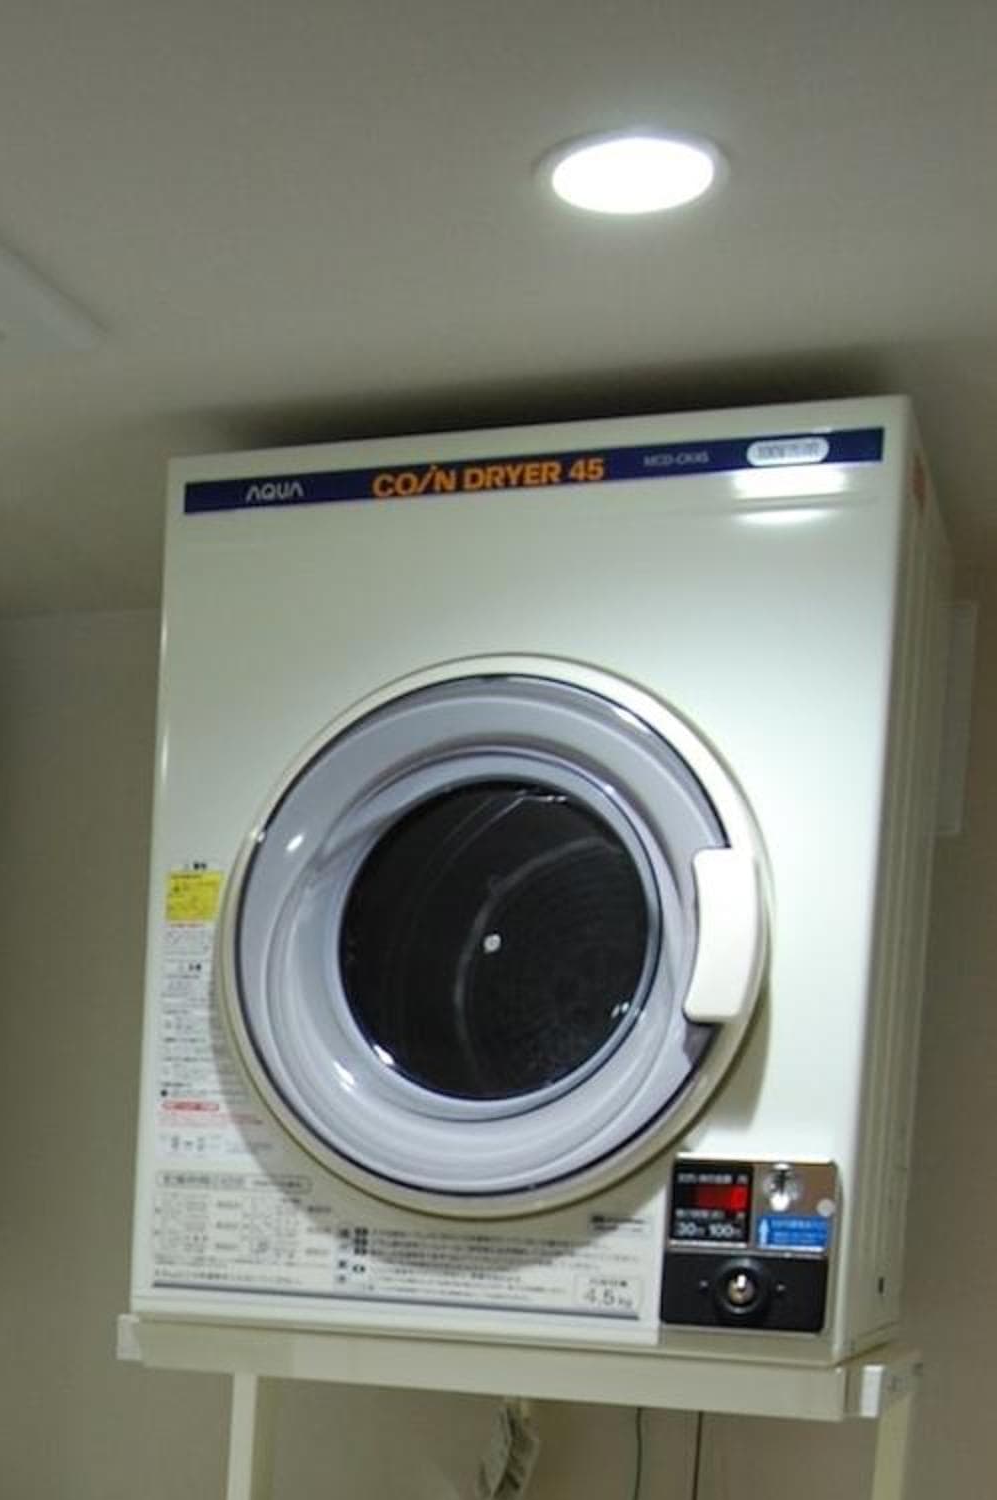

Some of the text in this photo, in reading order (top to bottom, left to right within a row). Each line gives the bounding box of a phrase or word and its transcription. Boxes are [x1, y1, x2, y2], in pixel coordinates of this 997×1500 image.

[462, 461, 562, 490] DRYER
[569, 457, 605, 481] 45
[245, 480, 303, 504] AQUA
